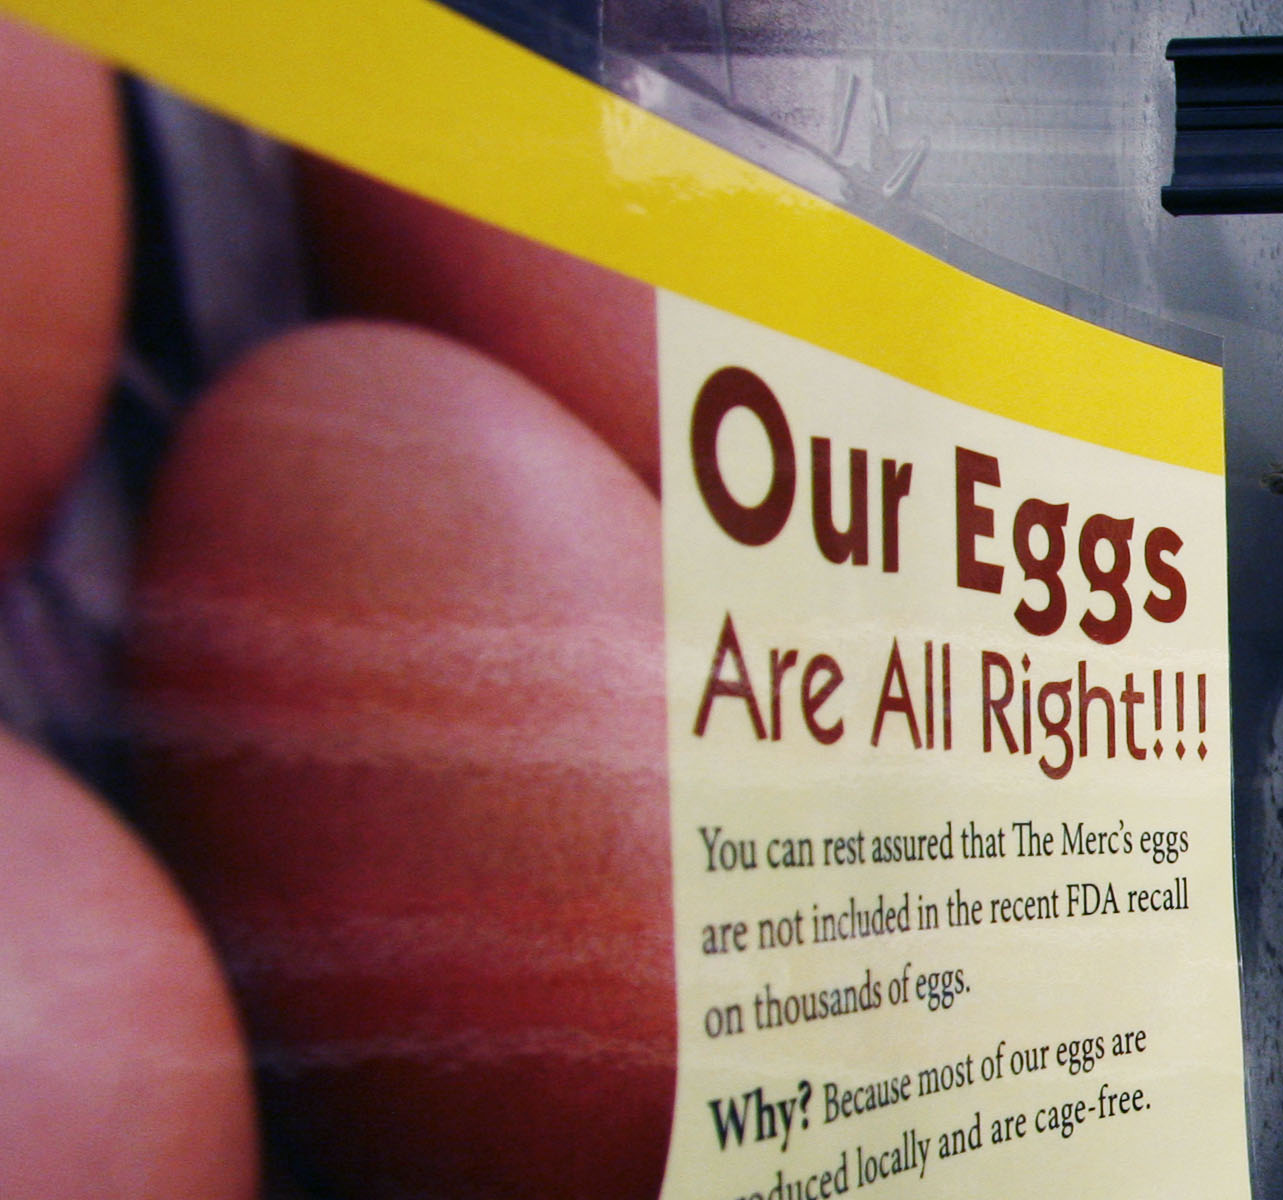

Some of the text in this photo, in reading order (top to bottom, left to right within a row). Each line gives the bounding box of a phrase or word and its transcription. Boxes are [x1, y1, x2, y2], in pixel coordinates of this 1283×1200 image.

[690, 365, 1188, 646] Our Eggs
[692, 609, 1209, 781] Are All Right!!!
[697, 818, 1190, 873] You can rest assured that The Merc's eggs
[701, 876, 1191, 957] are not included in the recent FDA recall
[704, 960, 972, 1040] on thousands of eggs.
[707, 1025, 1148, 1154] Why? Because most of our eggs are
[855, 1128, 932, 1187] locally
[937, 1110, 983, 1161] and
[989, 1103, 1027, 1146] are
[1033, 1081, 1152, 1140] cage-free.
